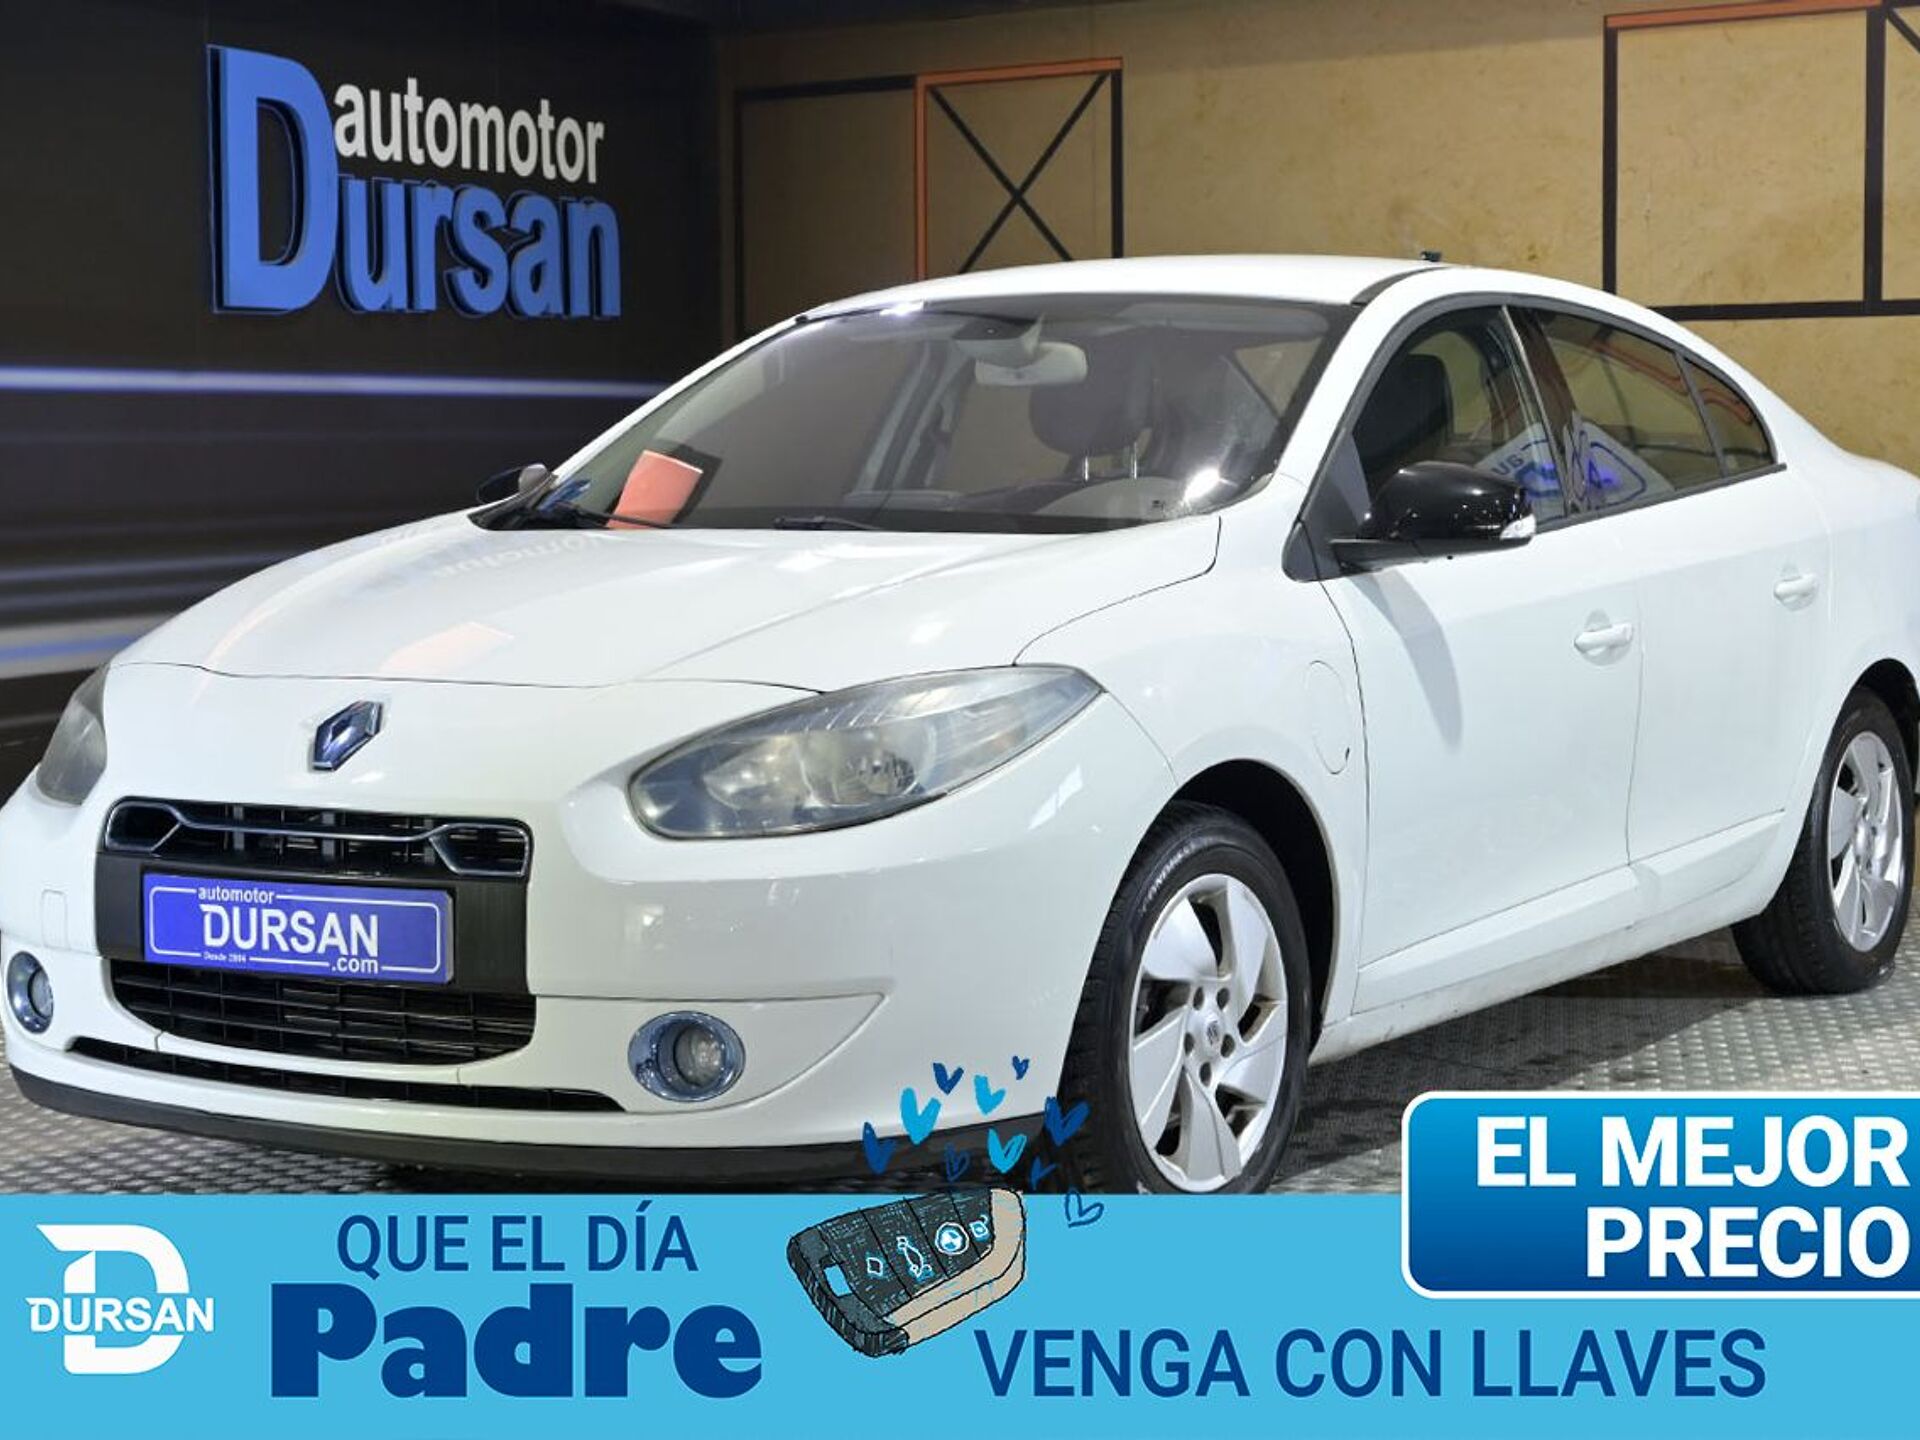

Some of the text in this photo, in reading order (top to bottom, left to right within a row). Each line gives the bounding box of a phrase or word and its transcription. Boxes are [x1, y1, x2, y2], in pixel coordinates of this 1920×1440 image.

[333, 77, 604, 183] automotor
[208, 45, 622, 317] Dursan
[197, 885, 275, 904] automotor
[200, 904, 378, 957] DURSAN
[331, 956, 379, 974] .com
